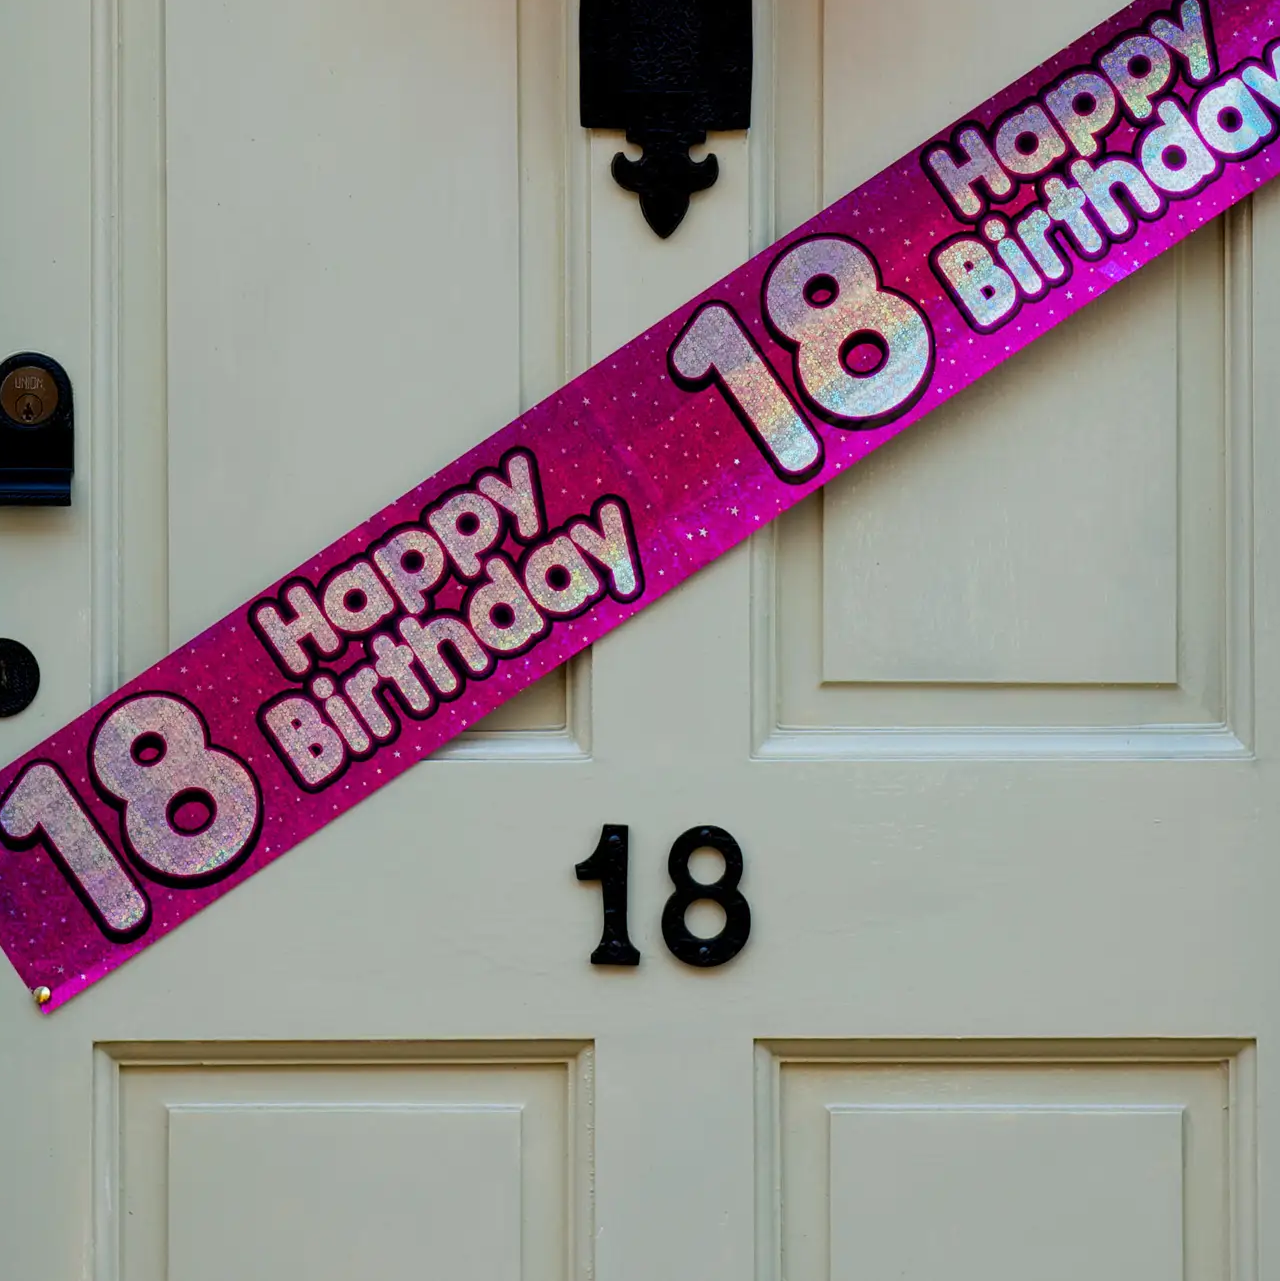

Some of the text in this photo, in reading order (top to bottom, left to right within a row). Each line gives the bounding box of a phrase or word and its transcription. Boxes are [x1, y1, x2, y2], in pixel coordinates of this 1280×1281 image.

[668, 233, 935, 483] 18
[250, 448, 545, 676] Happy
[258, 495, 643, 791] Birthday
[575, 824, 751, 967] 18
